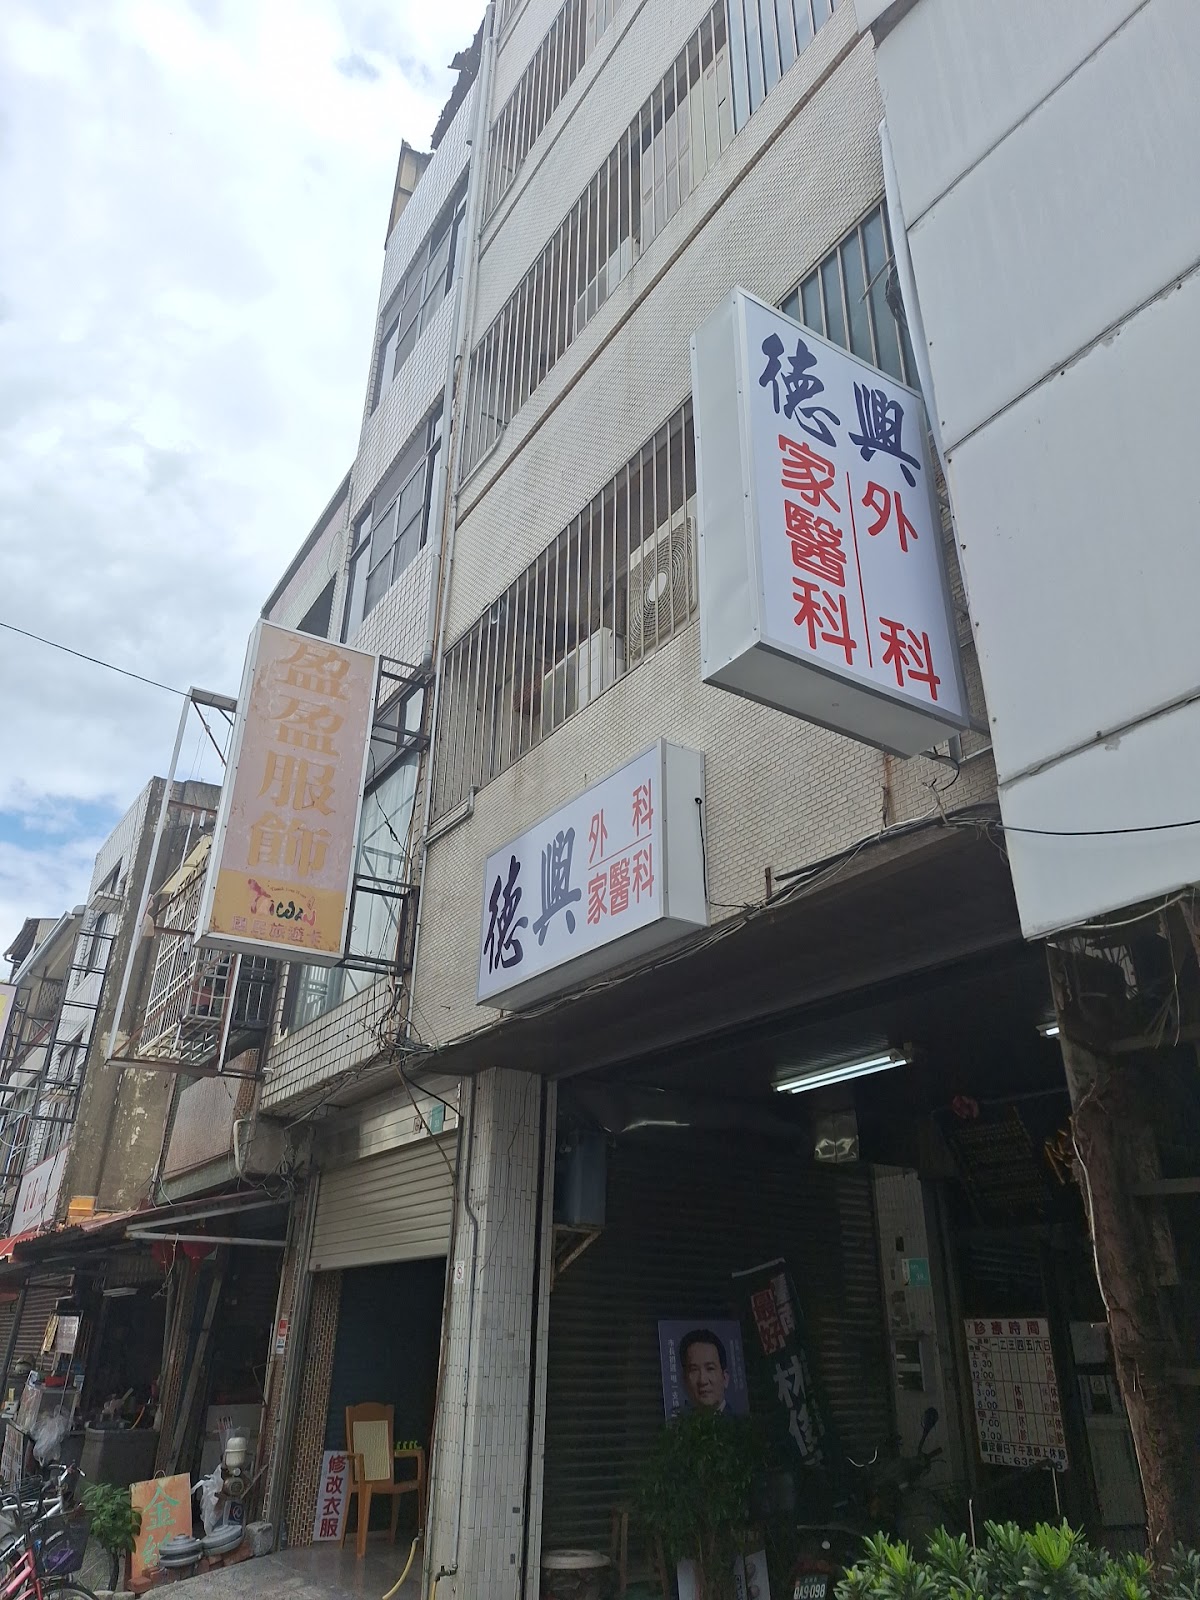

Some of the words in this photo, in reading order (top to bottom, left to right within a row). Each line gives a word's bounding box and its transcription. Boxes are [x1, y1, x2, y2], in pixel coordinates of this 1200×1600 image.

[758, 333, 921, 488] 德興
[777, 433, 857, 666] 家醫科
[861, 479, 941, 702] 外科
[248, 635, 352, 878] 盈盈服飾
[588, 778, 654, 864] 外科
[483, 826, 582, 975] 德興
[587, 843, 655, 925] 家醫科
[318, 1454, 347, 1539] 修改衣服
